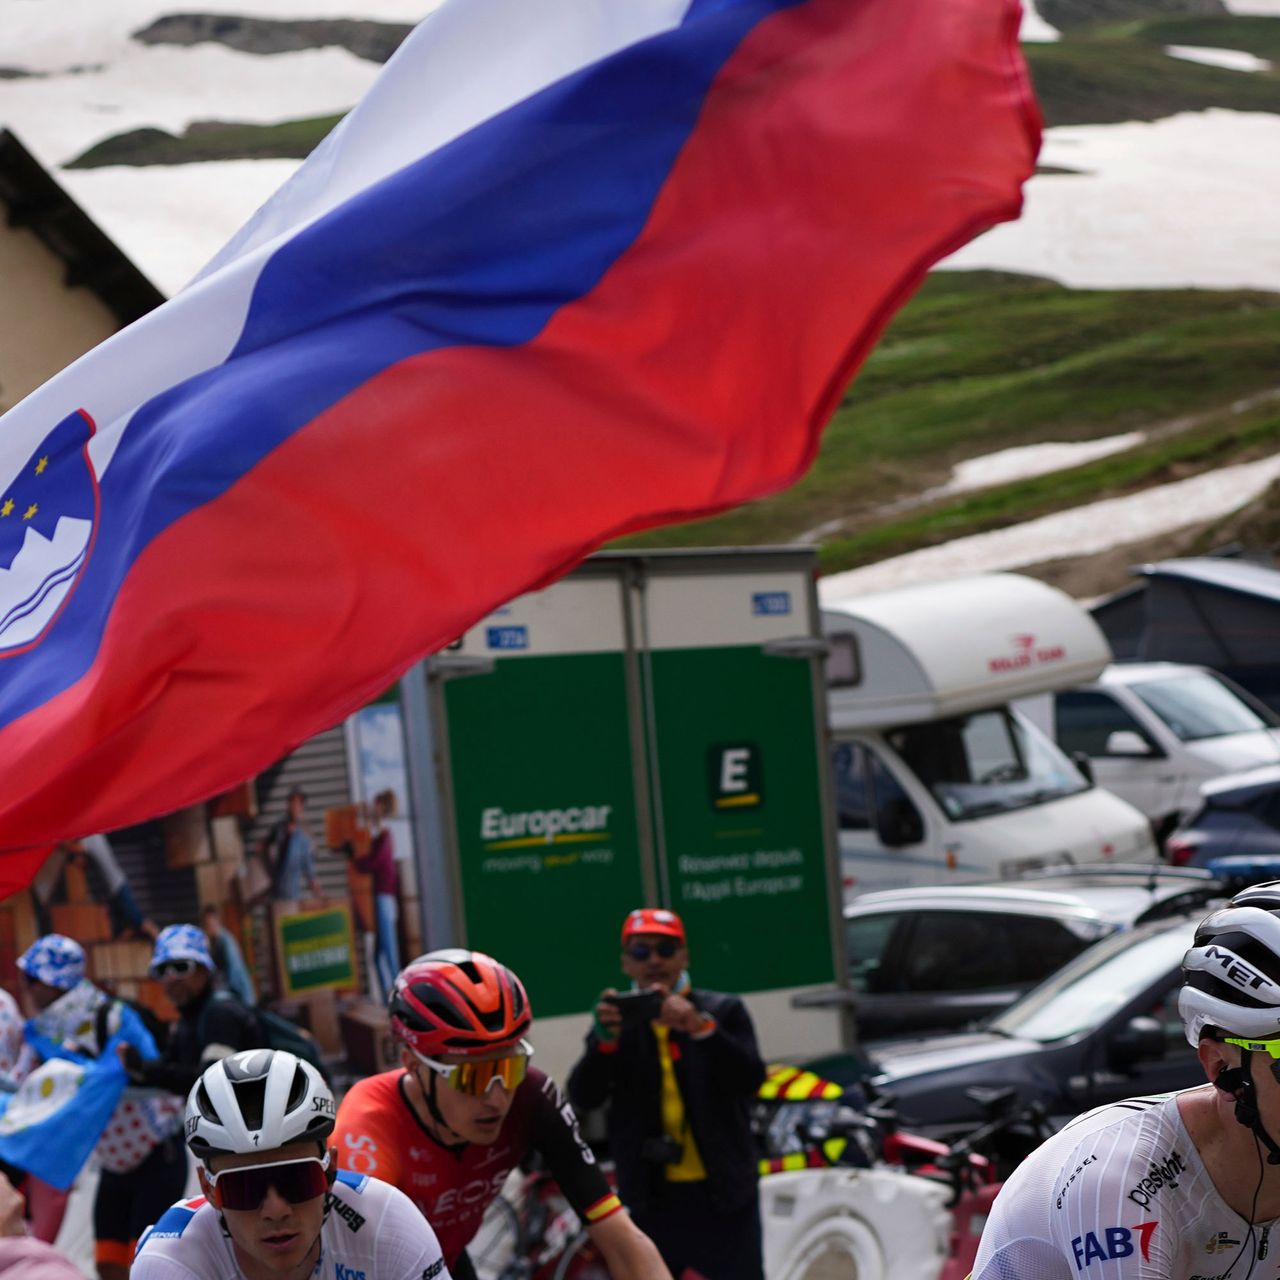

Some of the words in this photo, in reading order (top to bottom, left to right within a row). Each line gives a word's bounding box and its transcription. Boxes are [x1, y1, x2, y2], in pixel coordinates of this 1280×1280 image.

[720, 749, 750, 791] E
[479, 804, 612, 845] Europcar
[1204, 946, 1273, 990] MET
[1127, 1150, 1187, 1213] presight
[1071, 1226, 1135, 1272] FAB
